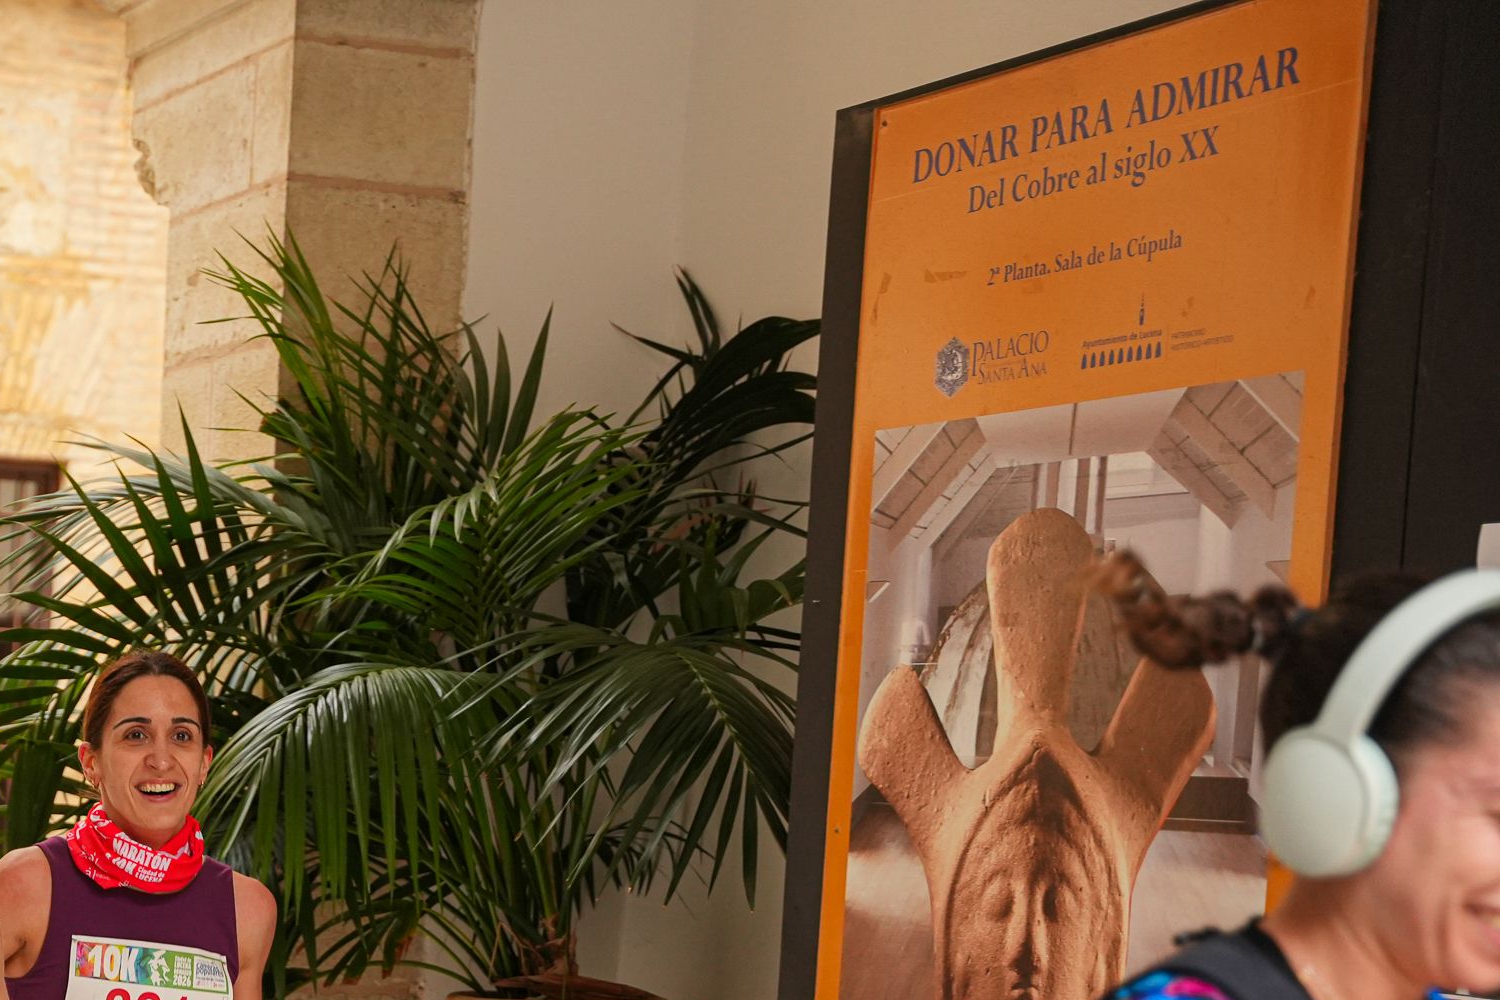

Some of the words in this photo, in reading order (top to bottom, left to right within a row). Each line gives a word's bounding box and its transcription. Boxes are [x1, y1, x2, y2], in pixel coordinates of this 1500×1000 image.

[912, 124, 1019, 183] DONAR
[1030, 98, 1114, 153] PARA
[1125, 47, 1300, 128] ADMIRAR
[967, 177, 1005, 213] Del
[1011, 166, 1080, 202] Cobre
[1086, 152, 1107, 185] al
[1113, 140, 1172, 188] siglo
[1178, 125, 1219, 164] XX
[1003, 262, 1051, 283] Planta.
[1054, 251, 1083, 273] Sala
[1086, 246, 1105, 266] de
[1109, 242, 1122, 262] la
[1126, 229, 1183, 262] Cúpula
[971, 330, 1049, 376] PALACIO
[88, 944, 141, 983] 10K
[172, 975, 192, 987] 2026
